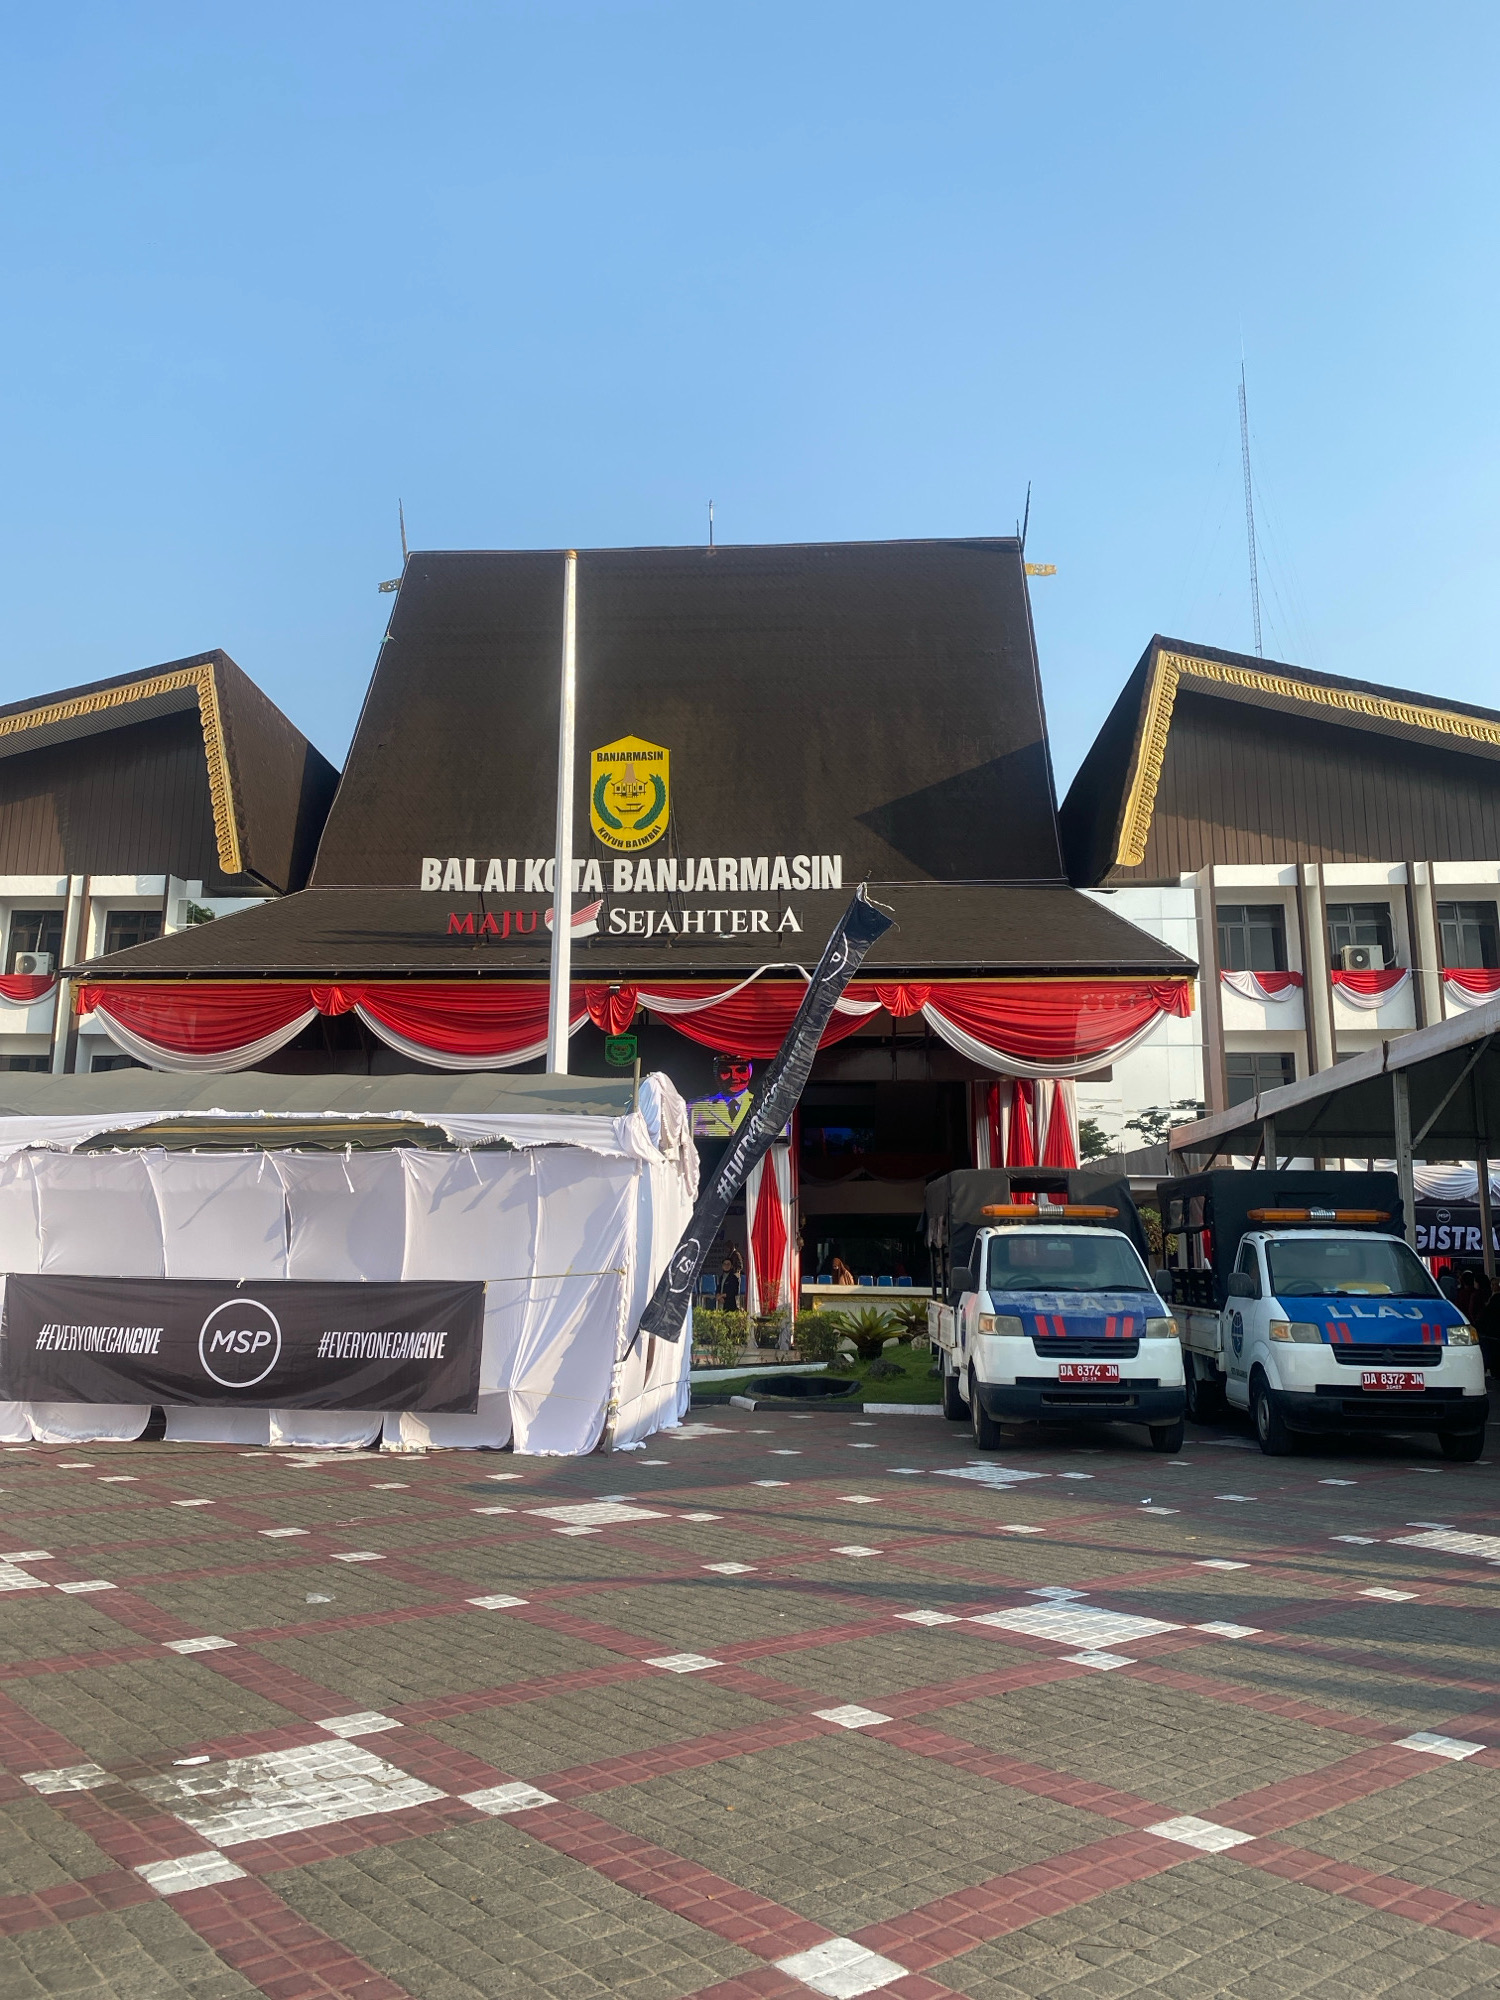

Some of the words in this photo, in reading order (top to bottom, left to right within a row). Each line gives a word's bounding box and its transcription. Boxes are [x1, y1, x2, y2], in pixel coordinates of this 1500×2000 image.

[596, 751, 664, 762] BANJARMASIN
[597, 826, 624, 848] KAYUH
[625, 824, 663, 848] BAIMBAI
[420, 857, 517, 892] BALAI
[613, 854, 843, 893] BANJARMASIN
[446, 909, 538, 939] MAJU
[608, 905, 804, 939] SEJAHTERA
[1326, 1305, 1424, 1320] LLAJ
[35, 1323, 164, 1354] #EVERYONECANGIVE
[209, 1329, 272, 1354] MSP
[317, 1331, 448, 1359] #EVERYONECANGIVE
[1060, 1365, 1074, 1377] DA
[1077, 1365, 1101, 1377] 8374
[1105, 1365, 1118, 1377] JN
[1363, 1373, 1377, 1385] DA
[1381, 1373, 1406, 1385] 8372
[1410, 1373, 1424, 1385] JN
